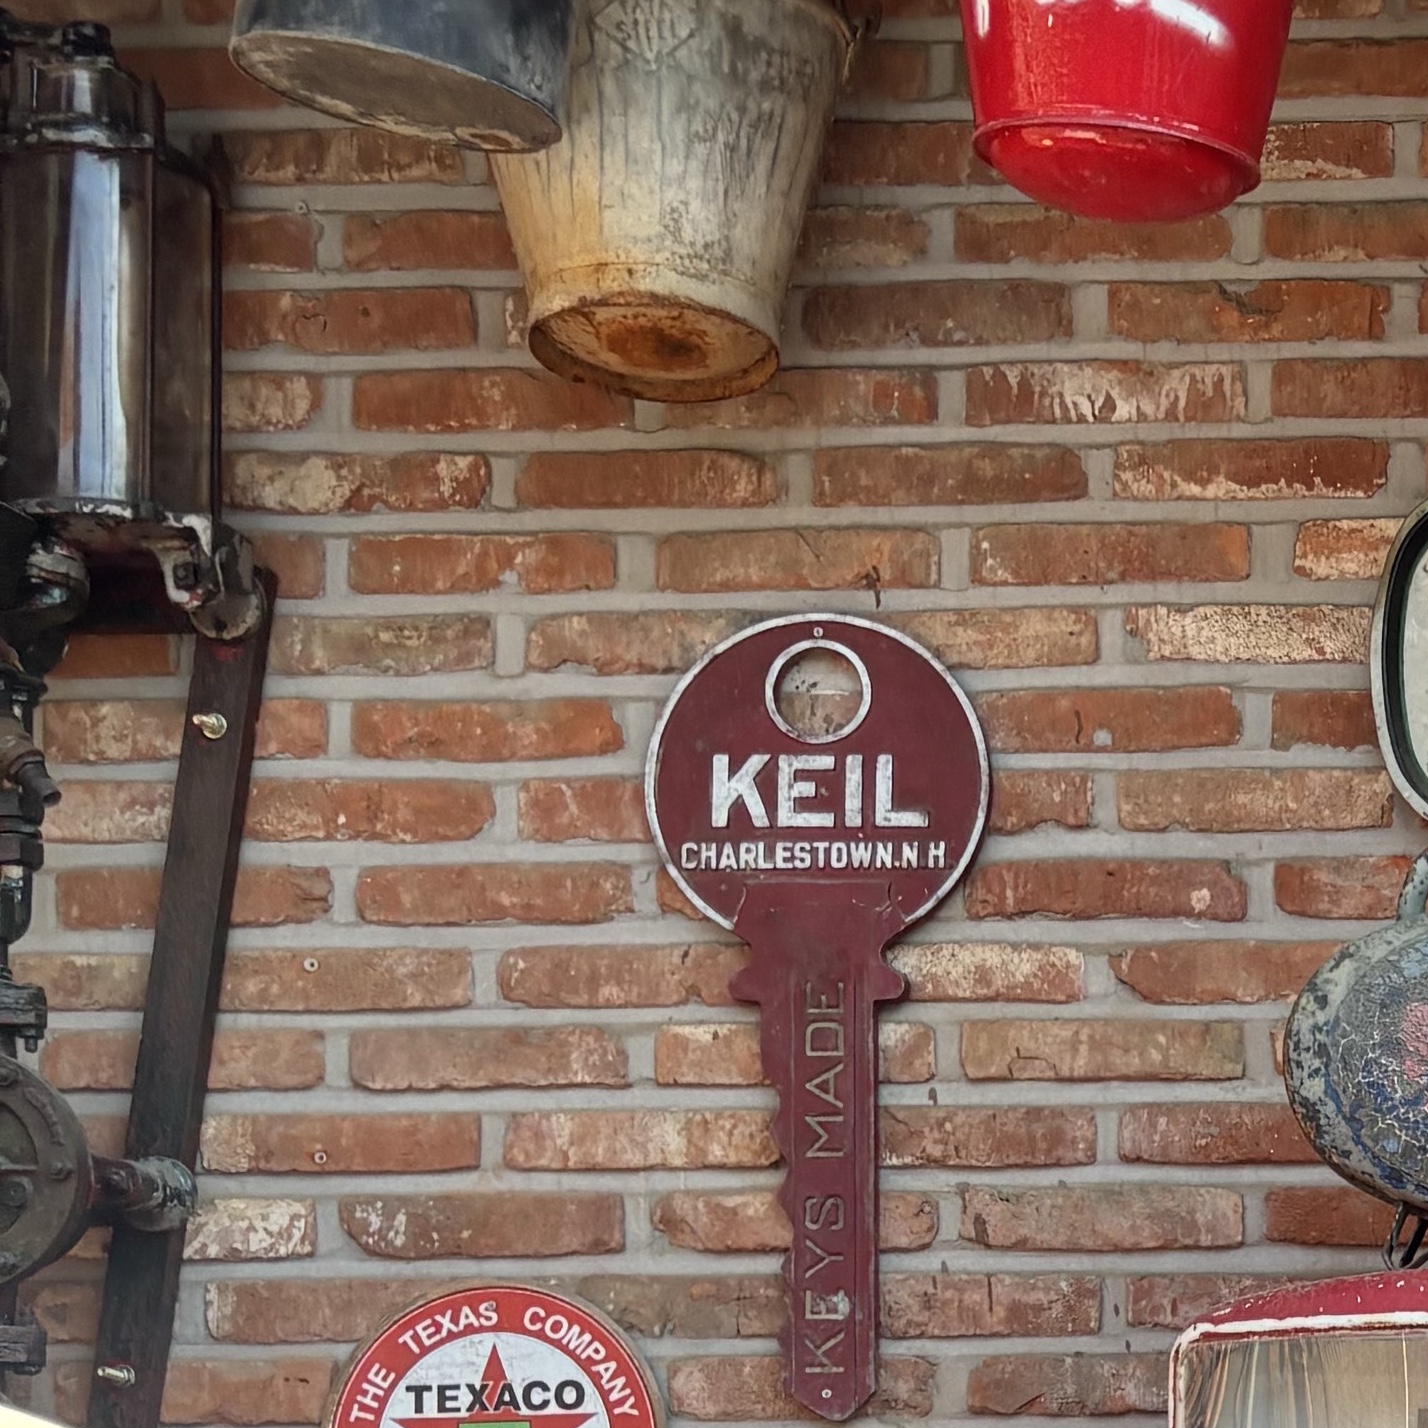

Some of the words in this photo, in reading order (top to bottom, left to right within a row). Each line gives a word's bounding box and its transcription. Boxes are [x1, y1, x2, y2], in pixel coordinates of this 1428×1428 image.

[711, 754, 930, 828] KEIL
[805, 981, 845, 1158] MADE
[805, 1195, 846, 1374] KEYS
[349, 1363, 396, 1423] THE
[398, 1301, 498, 1355] TEXAS
[524, 1306, 639, 1418] COMPANY
[405, 1379, 586, 1414] TEXACO
